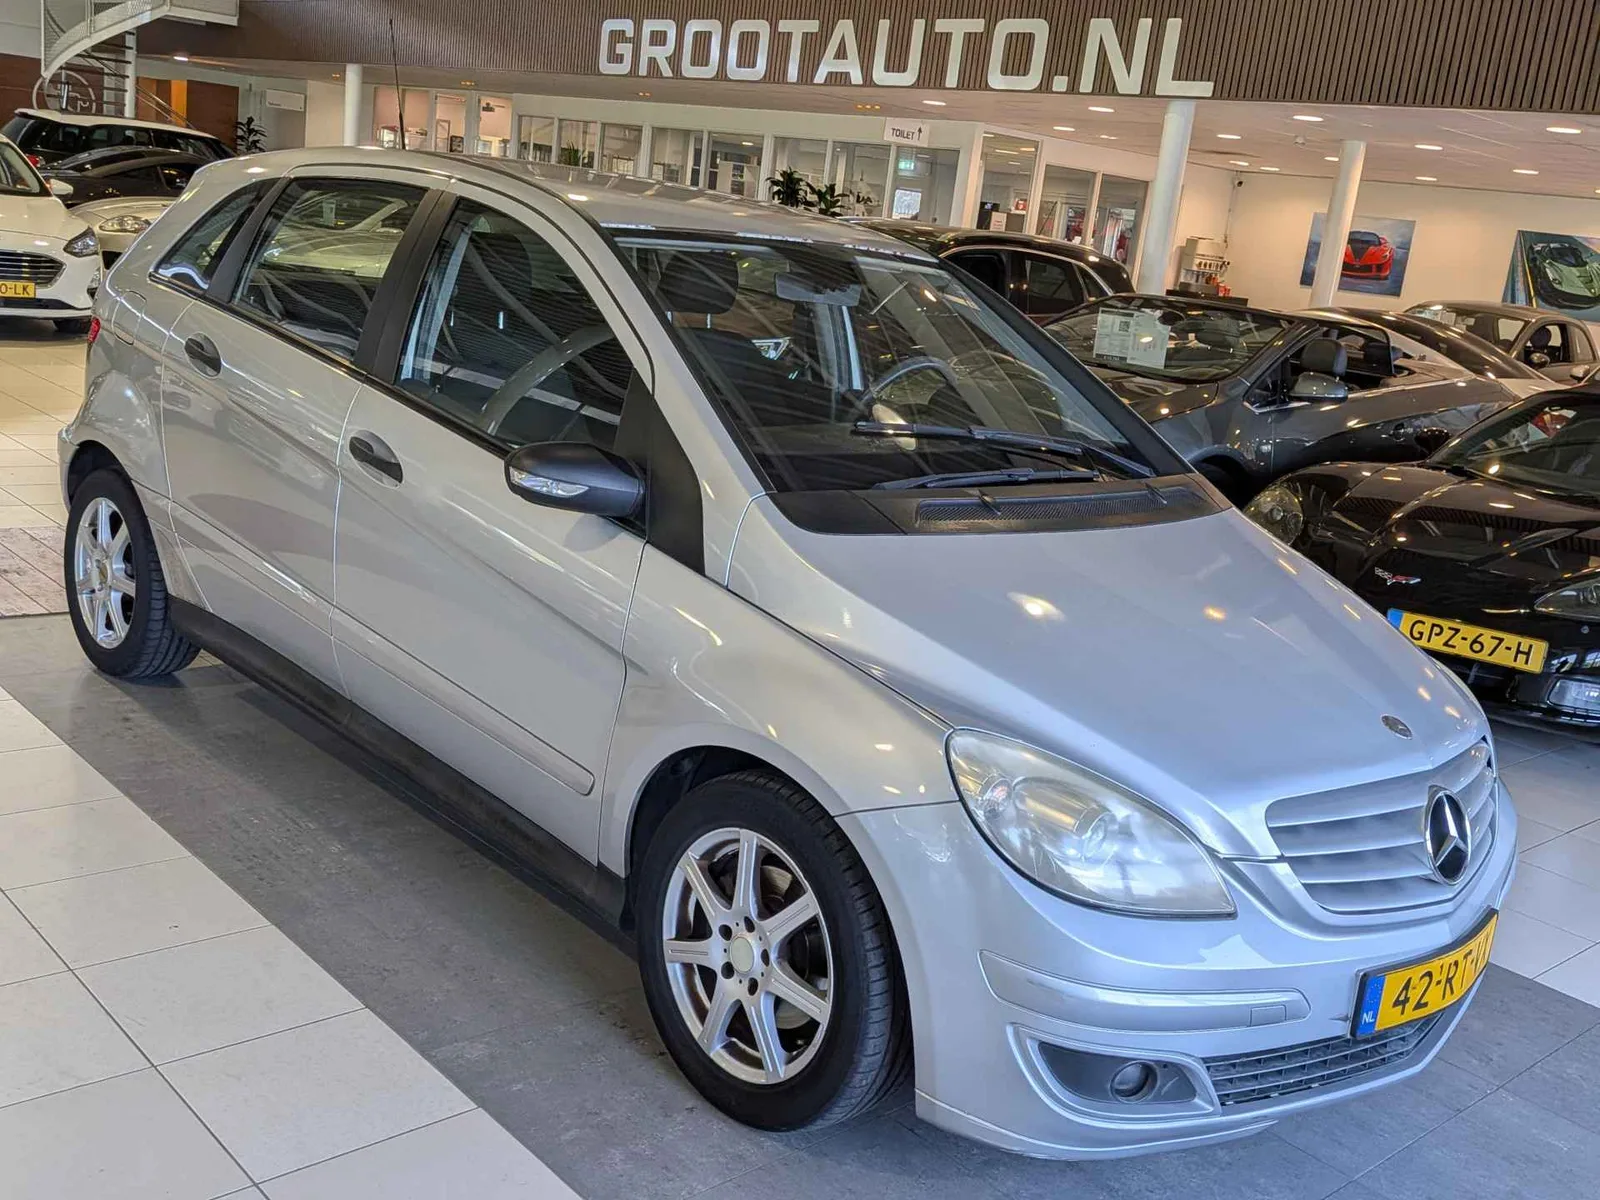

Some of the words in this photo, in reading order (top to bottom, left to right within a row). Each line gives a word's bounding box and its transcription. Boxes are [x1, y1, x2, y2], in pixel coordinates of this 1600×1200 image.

[598, 17, 1214, 98] GROOTAUTO.NL
[891, 127, 915, 140] TOILET
[1409, 619, 1533, 665] GPZ-67-H
[1362, 1011, 1375, 1025] NL
